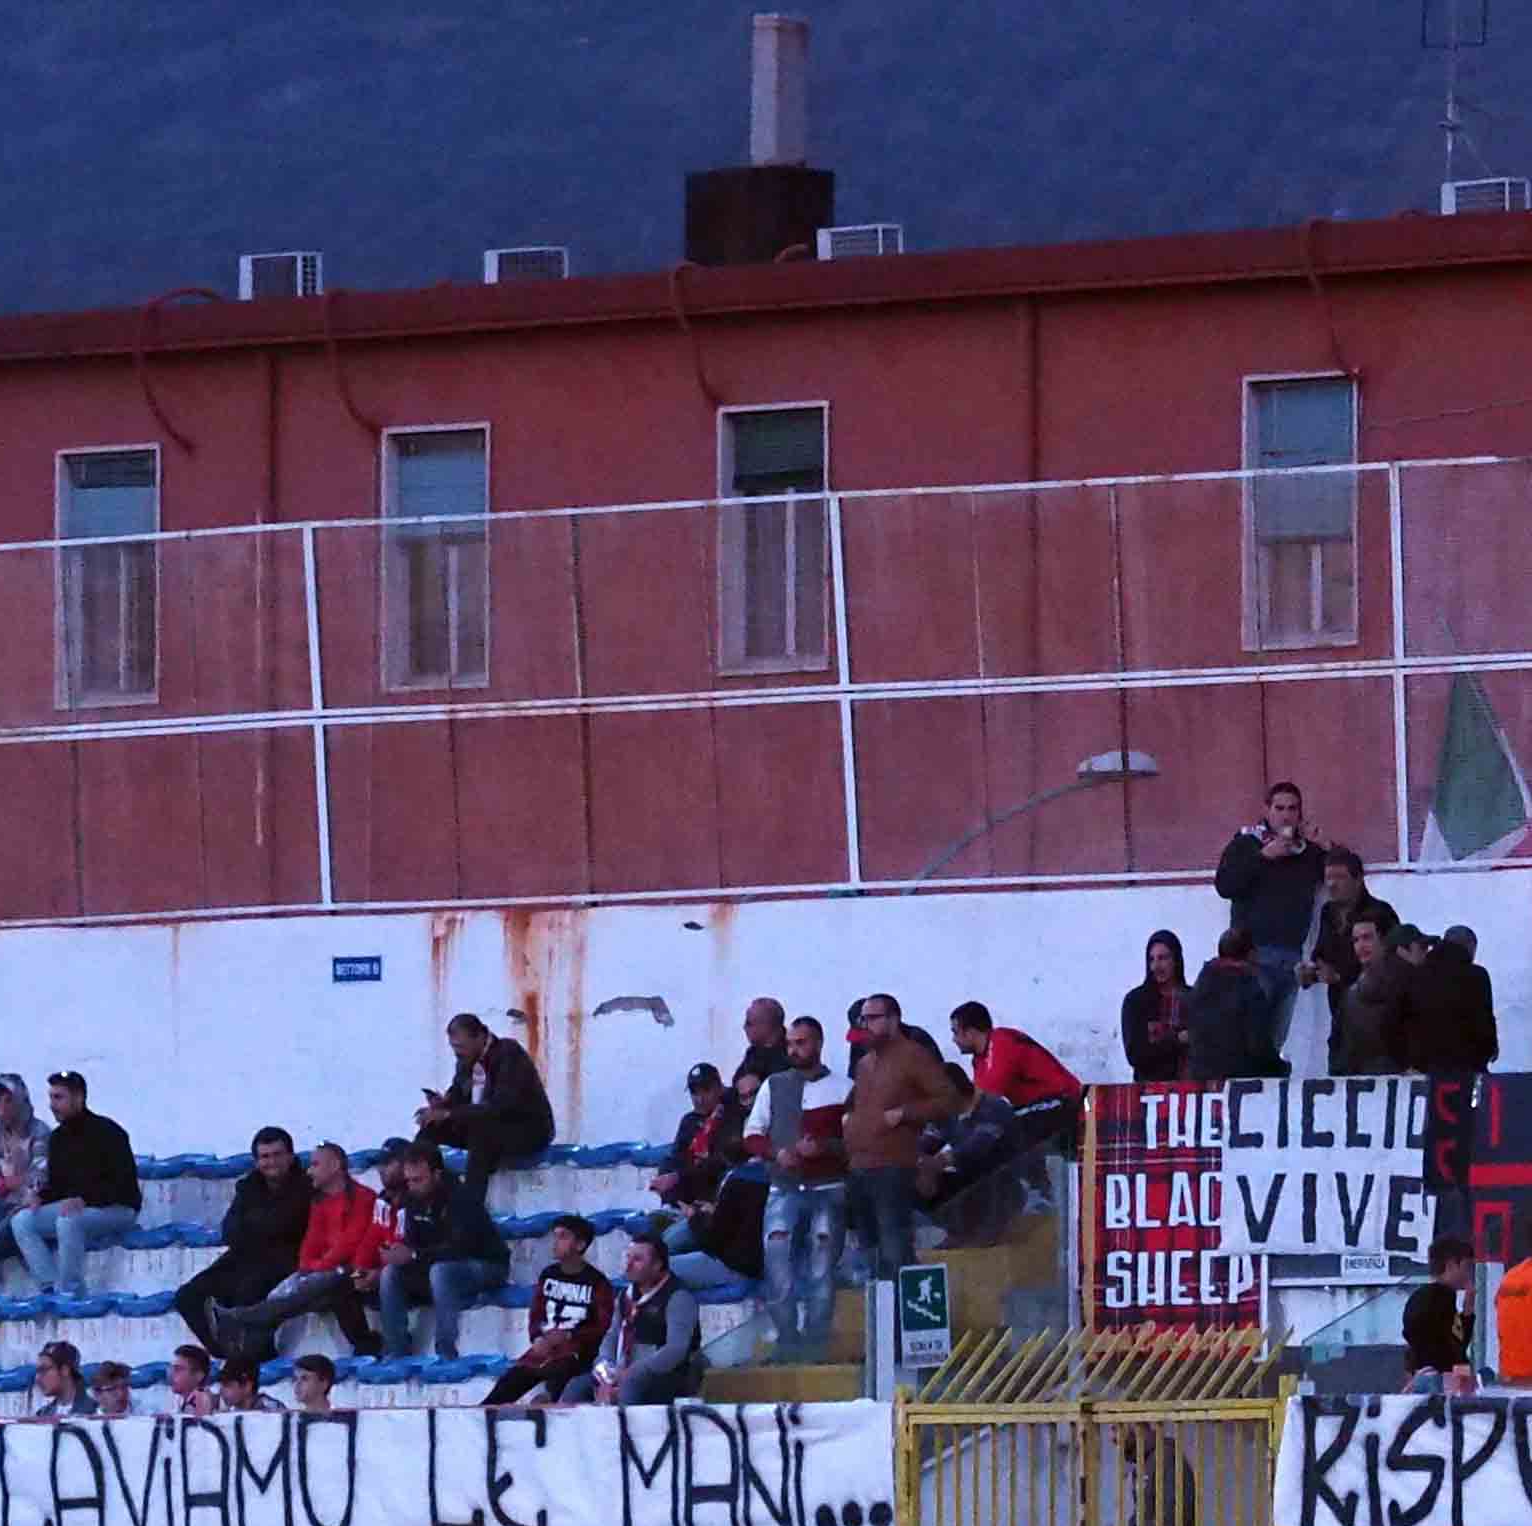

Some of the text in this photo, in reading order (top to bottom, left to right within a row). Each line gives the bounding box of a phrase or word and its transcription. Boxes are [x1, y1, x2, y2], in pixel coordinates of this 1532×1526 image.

[1139, 1092, 1223, 1149] THE
[1105, 1170, 1223, 1230] BLAC
[1104, 1249, 1255, 1309] SHEEP
